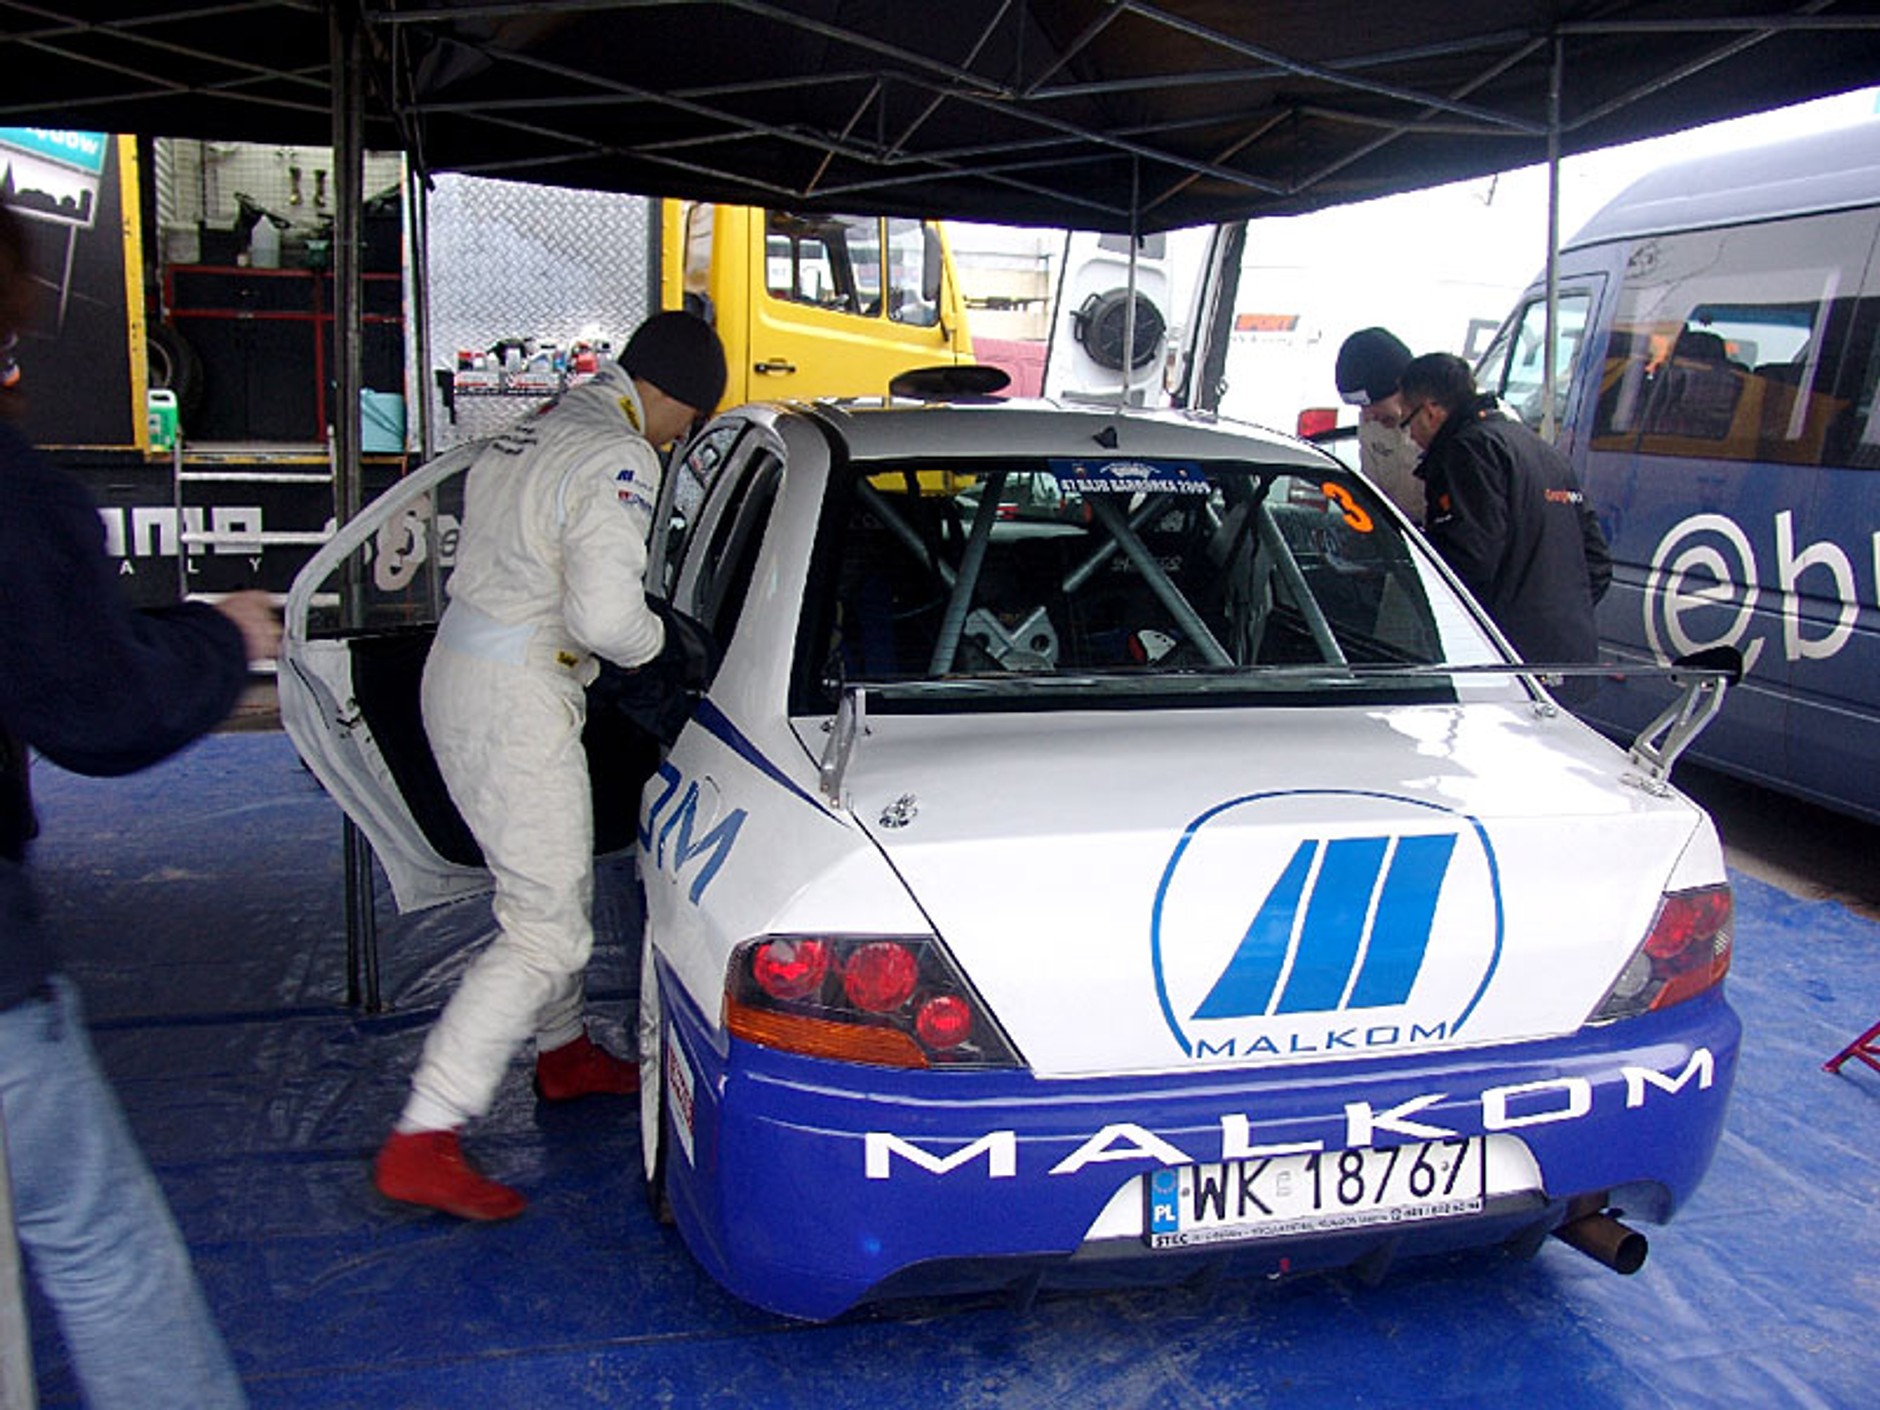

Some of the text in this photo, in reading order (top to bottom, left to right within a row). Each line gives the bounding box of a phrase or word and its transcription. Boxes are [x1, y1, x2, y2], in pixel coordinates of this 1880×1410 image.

[1322, 482, 1374, 532] 3
[1198, 1022, 1448, 1057] MALKOM
[865, 1047, 1714, 1179] MALKOM
[1192, 1158, 1273, 1221] WK
[1305, 1137, 1469, 1209] 18767
[1154, 1204, 1176, 1223] PL
